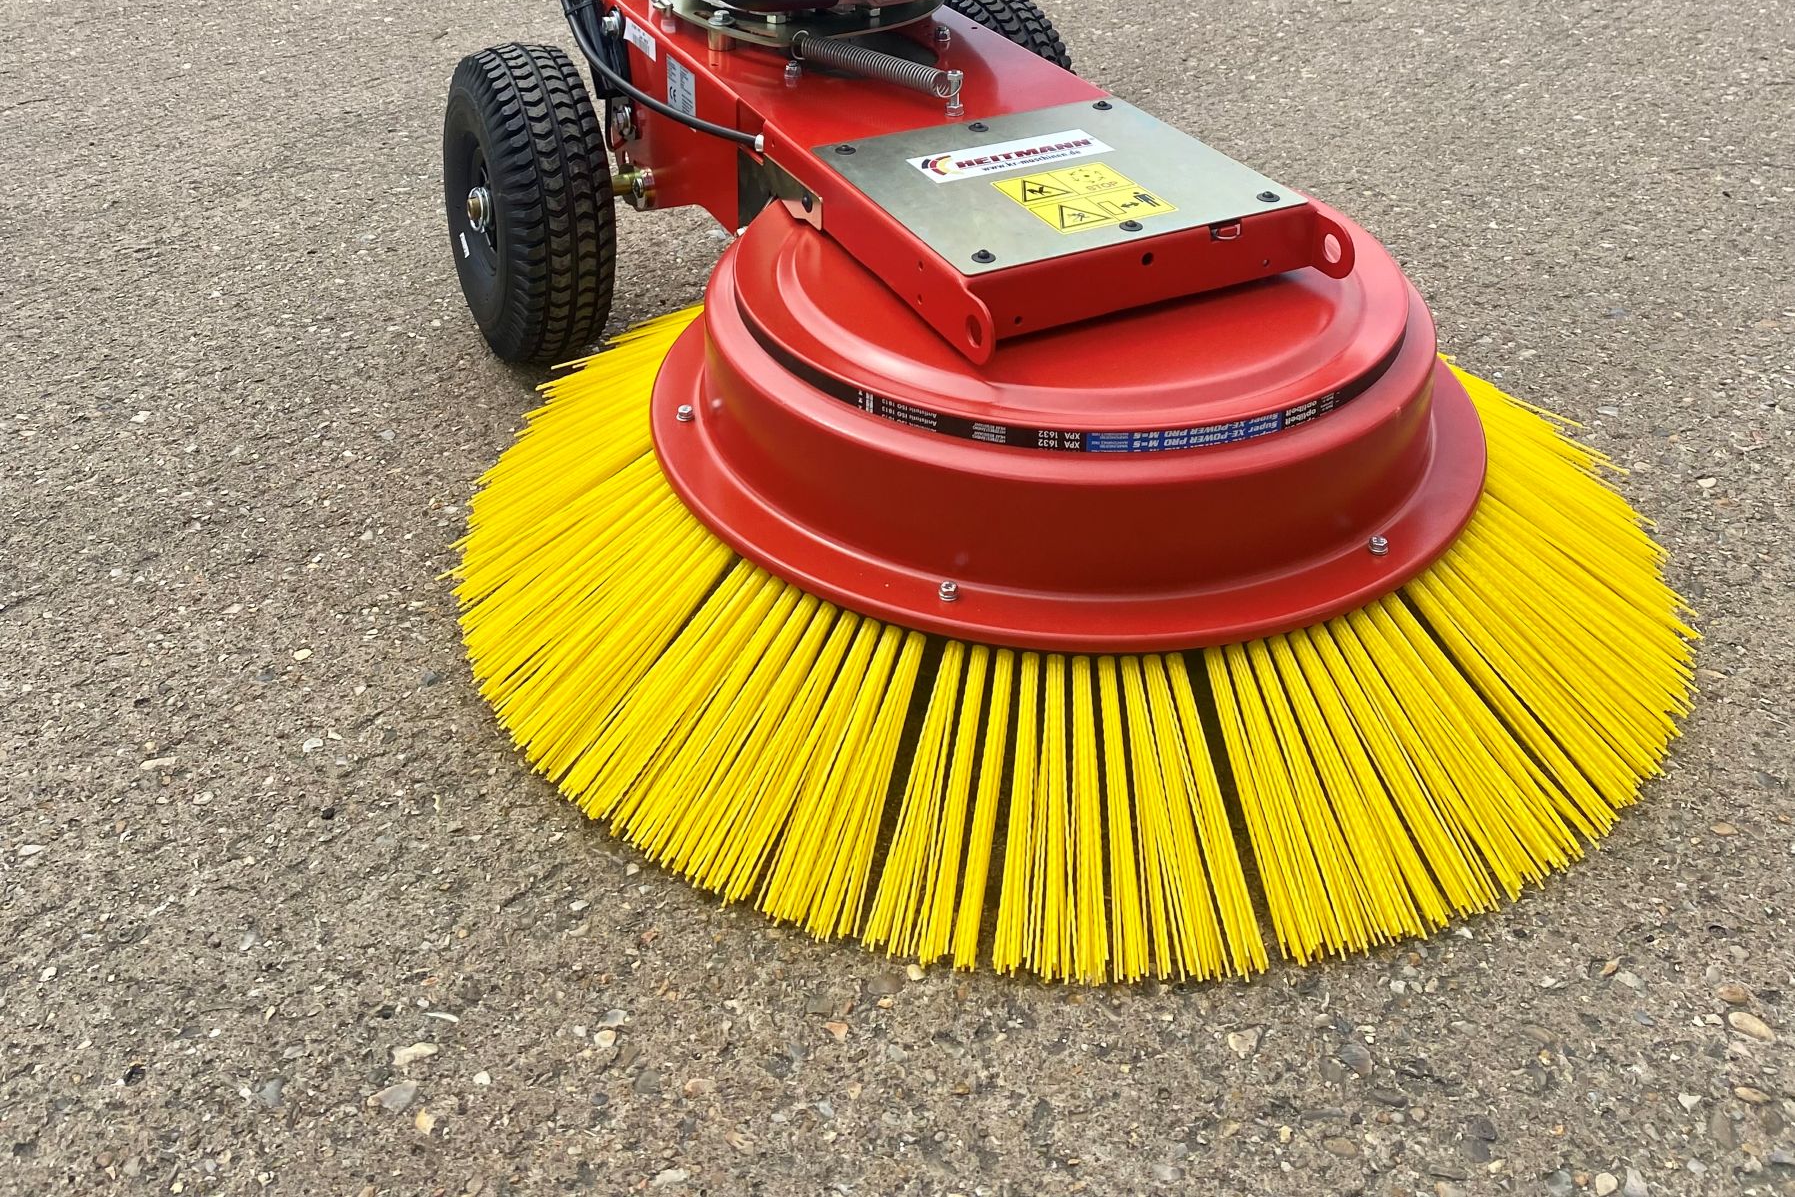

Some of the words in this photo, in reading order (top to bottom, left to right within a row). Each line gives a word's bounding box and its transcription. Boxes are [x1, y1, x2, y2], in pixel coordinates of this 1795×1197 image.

[955, 138, 1092, 169] HEITMANN
[981, 150, 1082, 172] www.kr-maschinen.de
[1085, 181, 1118, 191] STOP
[897, 411, 907, 419] ISO
[1285, 409, 1316, 425] optibelt
[1248, 421, 1278, 432] Super
[1038, 430, 1058, 438] 1632
[1164, 429, 1187, 437] PRO
[1190, 428, 1245, 444] XE-POWER
[1038, 439, 1058, 447] 1632
[1064, 440, 1080, 448] XPA
[1164, 437, 1187, 446] PRO
